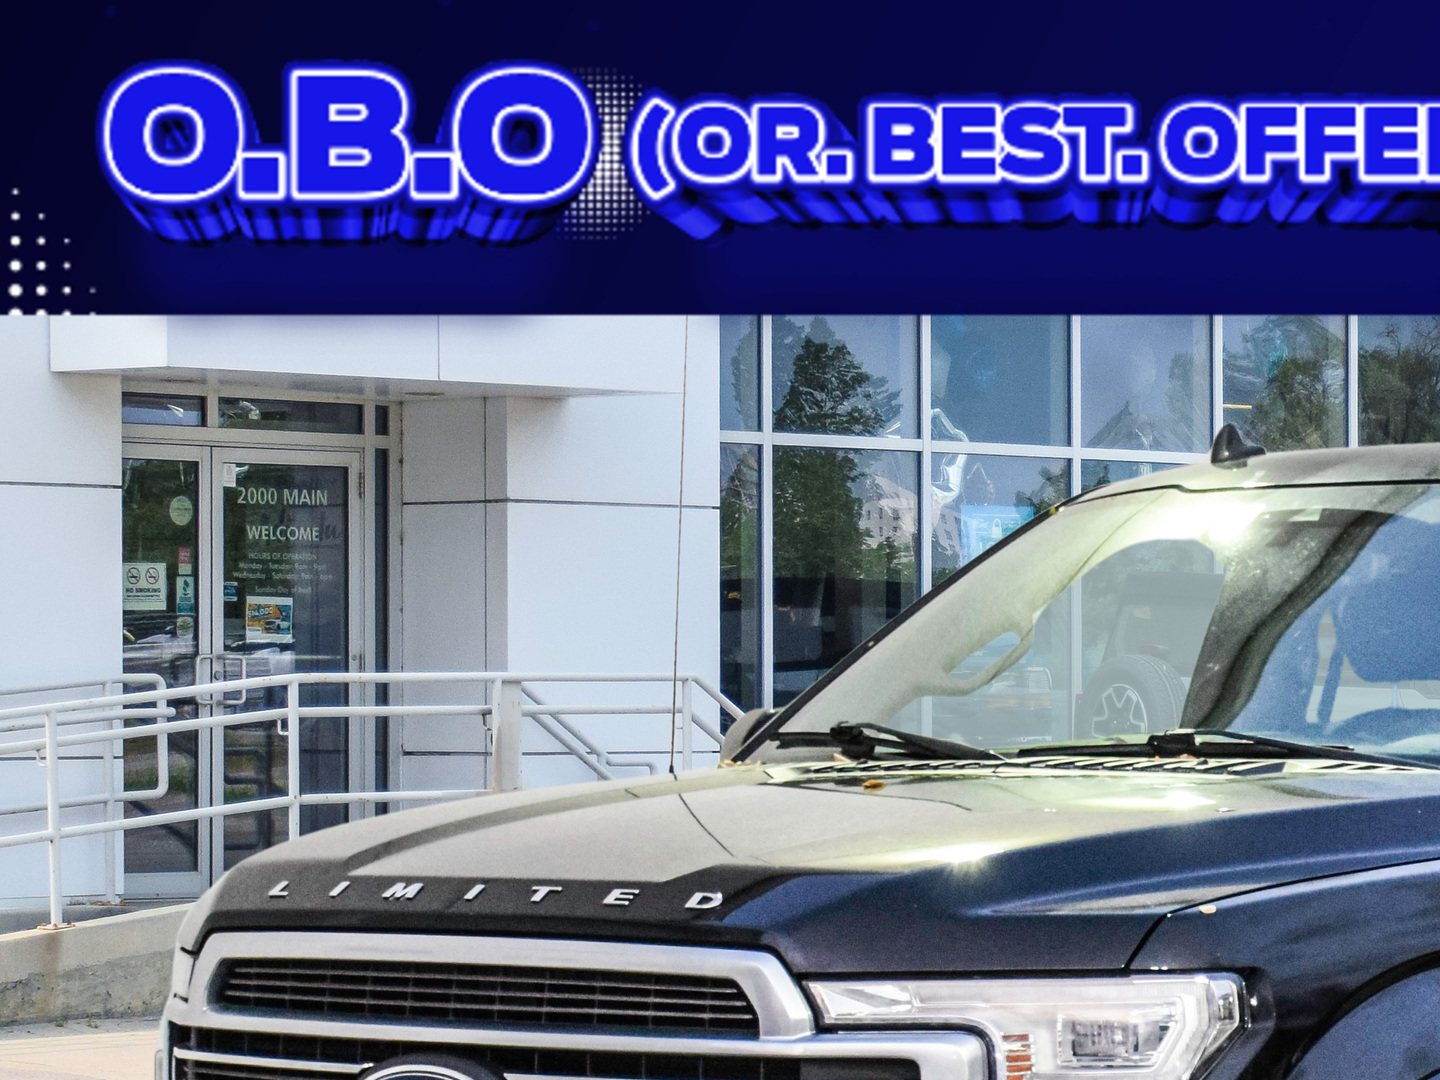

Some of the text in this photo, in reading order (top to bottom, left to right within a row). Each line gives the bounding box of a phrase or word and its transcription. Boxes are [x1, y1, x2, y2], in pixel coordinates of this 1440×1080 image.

[237, 488, 328, 506] 2000 MAIN
[246, 525, 320, 541] WELCOME
[248, 552, 271, 560] HOURS
[272, 552, 281, 560] OF
[268, 880, 724, 910] LIMITED
